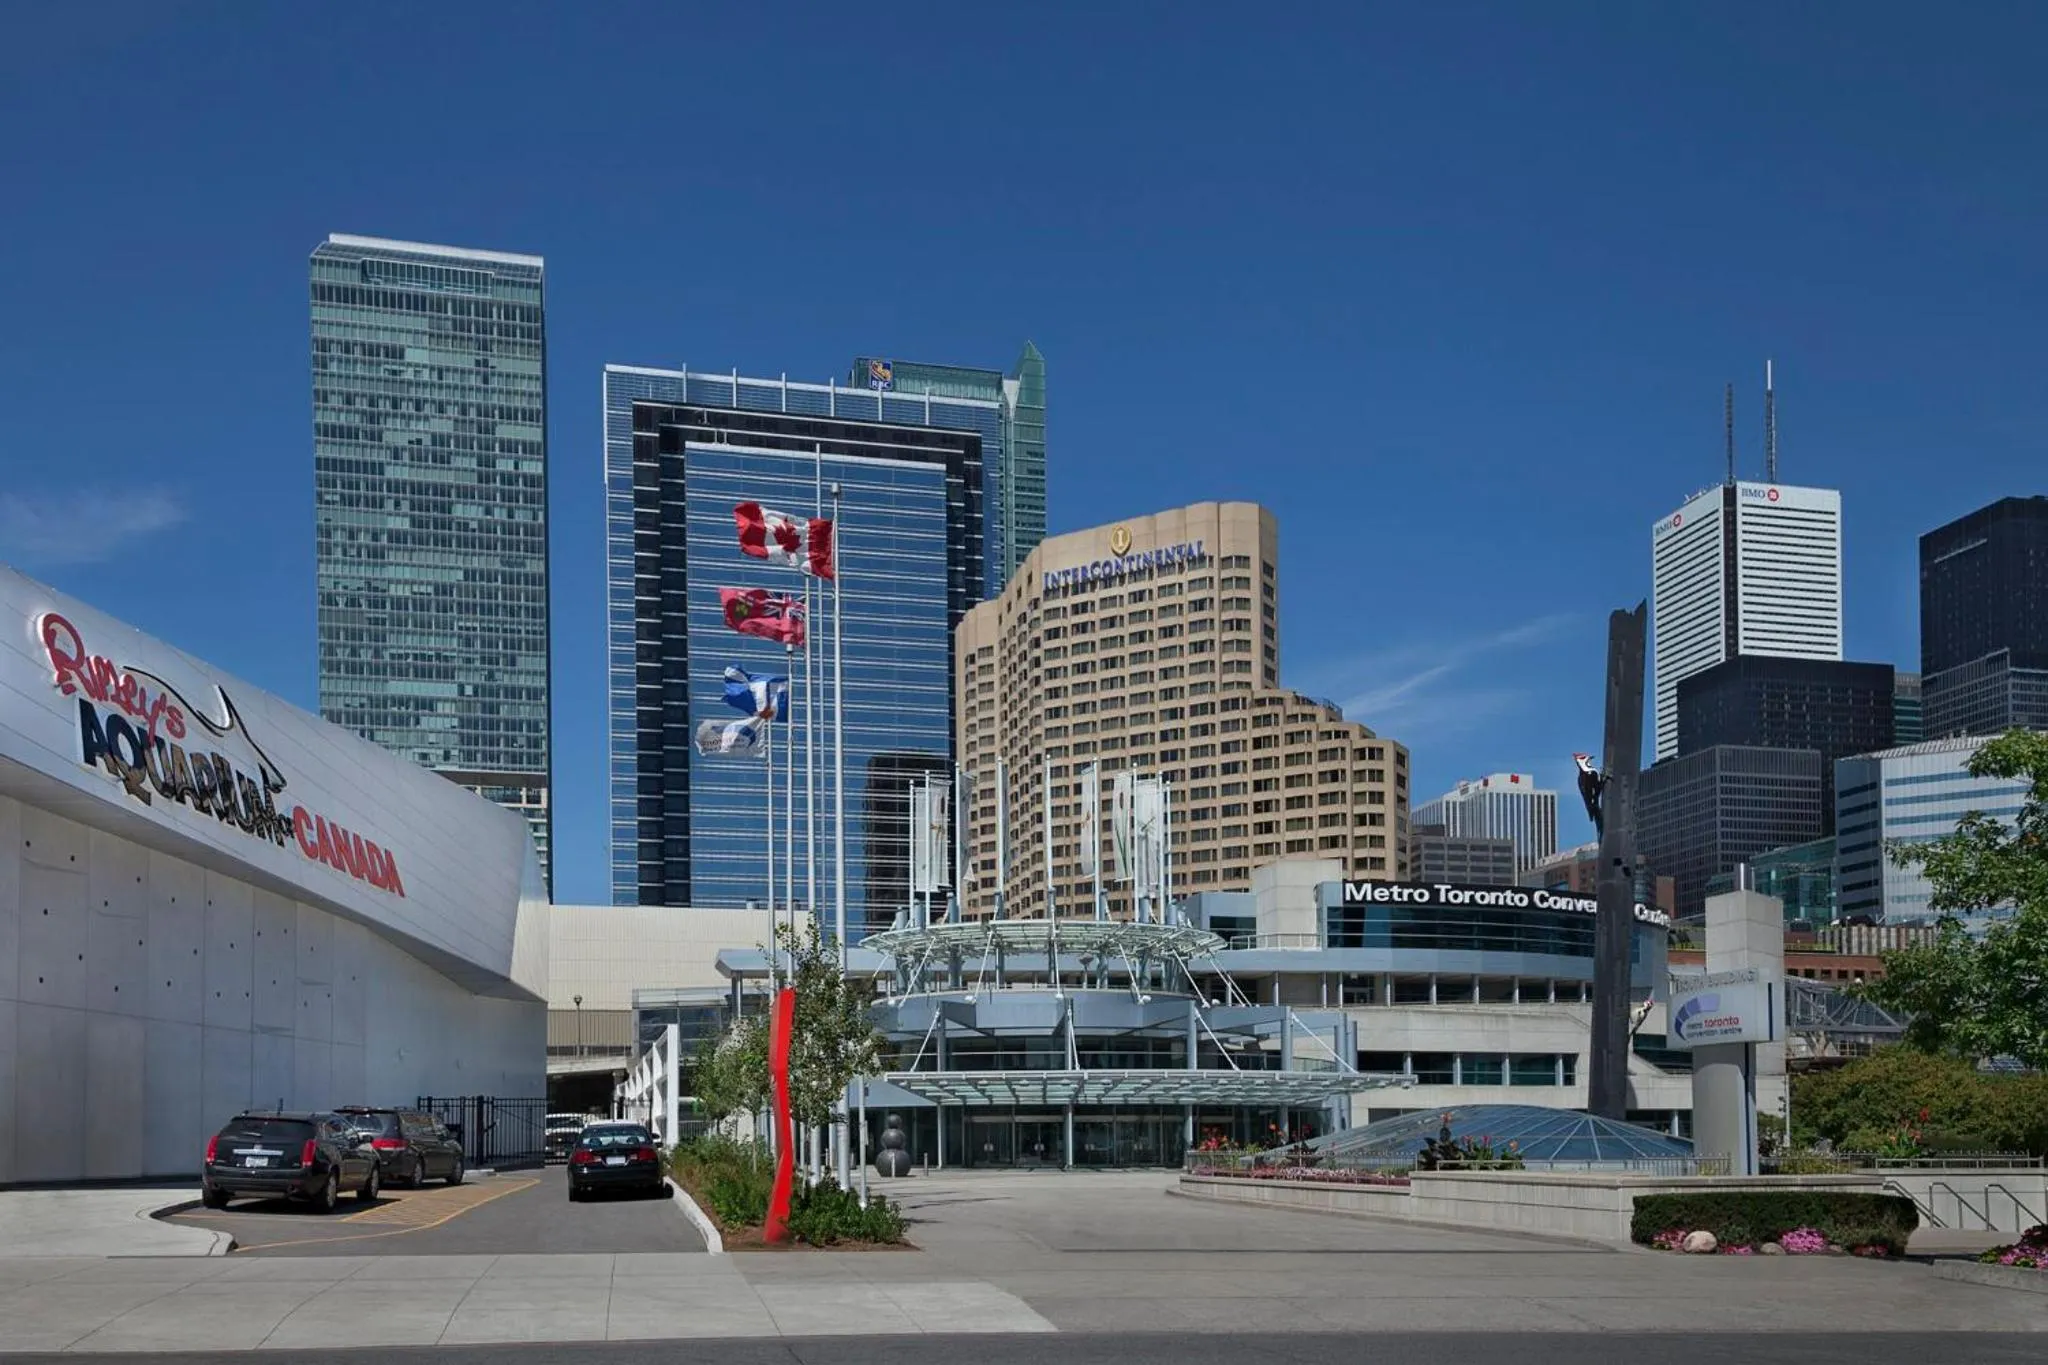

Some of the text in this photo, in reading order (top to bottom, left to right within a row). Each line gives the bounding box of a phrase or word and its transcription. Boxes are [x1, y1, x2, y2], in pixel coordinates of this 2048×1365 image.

[1741, 488, 1766, 499] BMO
[1043, 540, 1205, 589] INTERCONTINENTAL
[42, 613, 186, 748] Ripley's
[79, 698, 285, 848] AQUARIUM
[292, 805, 405, 898] CANADA
[1345, 883, 1430, 903] Metro
[1434, 884, 1529, 907] Toronto
[1533, 890, 1597, 913] Conve
[1704, 1016, 1740, 1028] toronto
